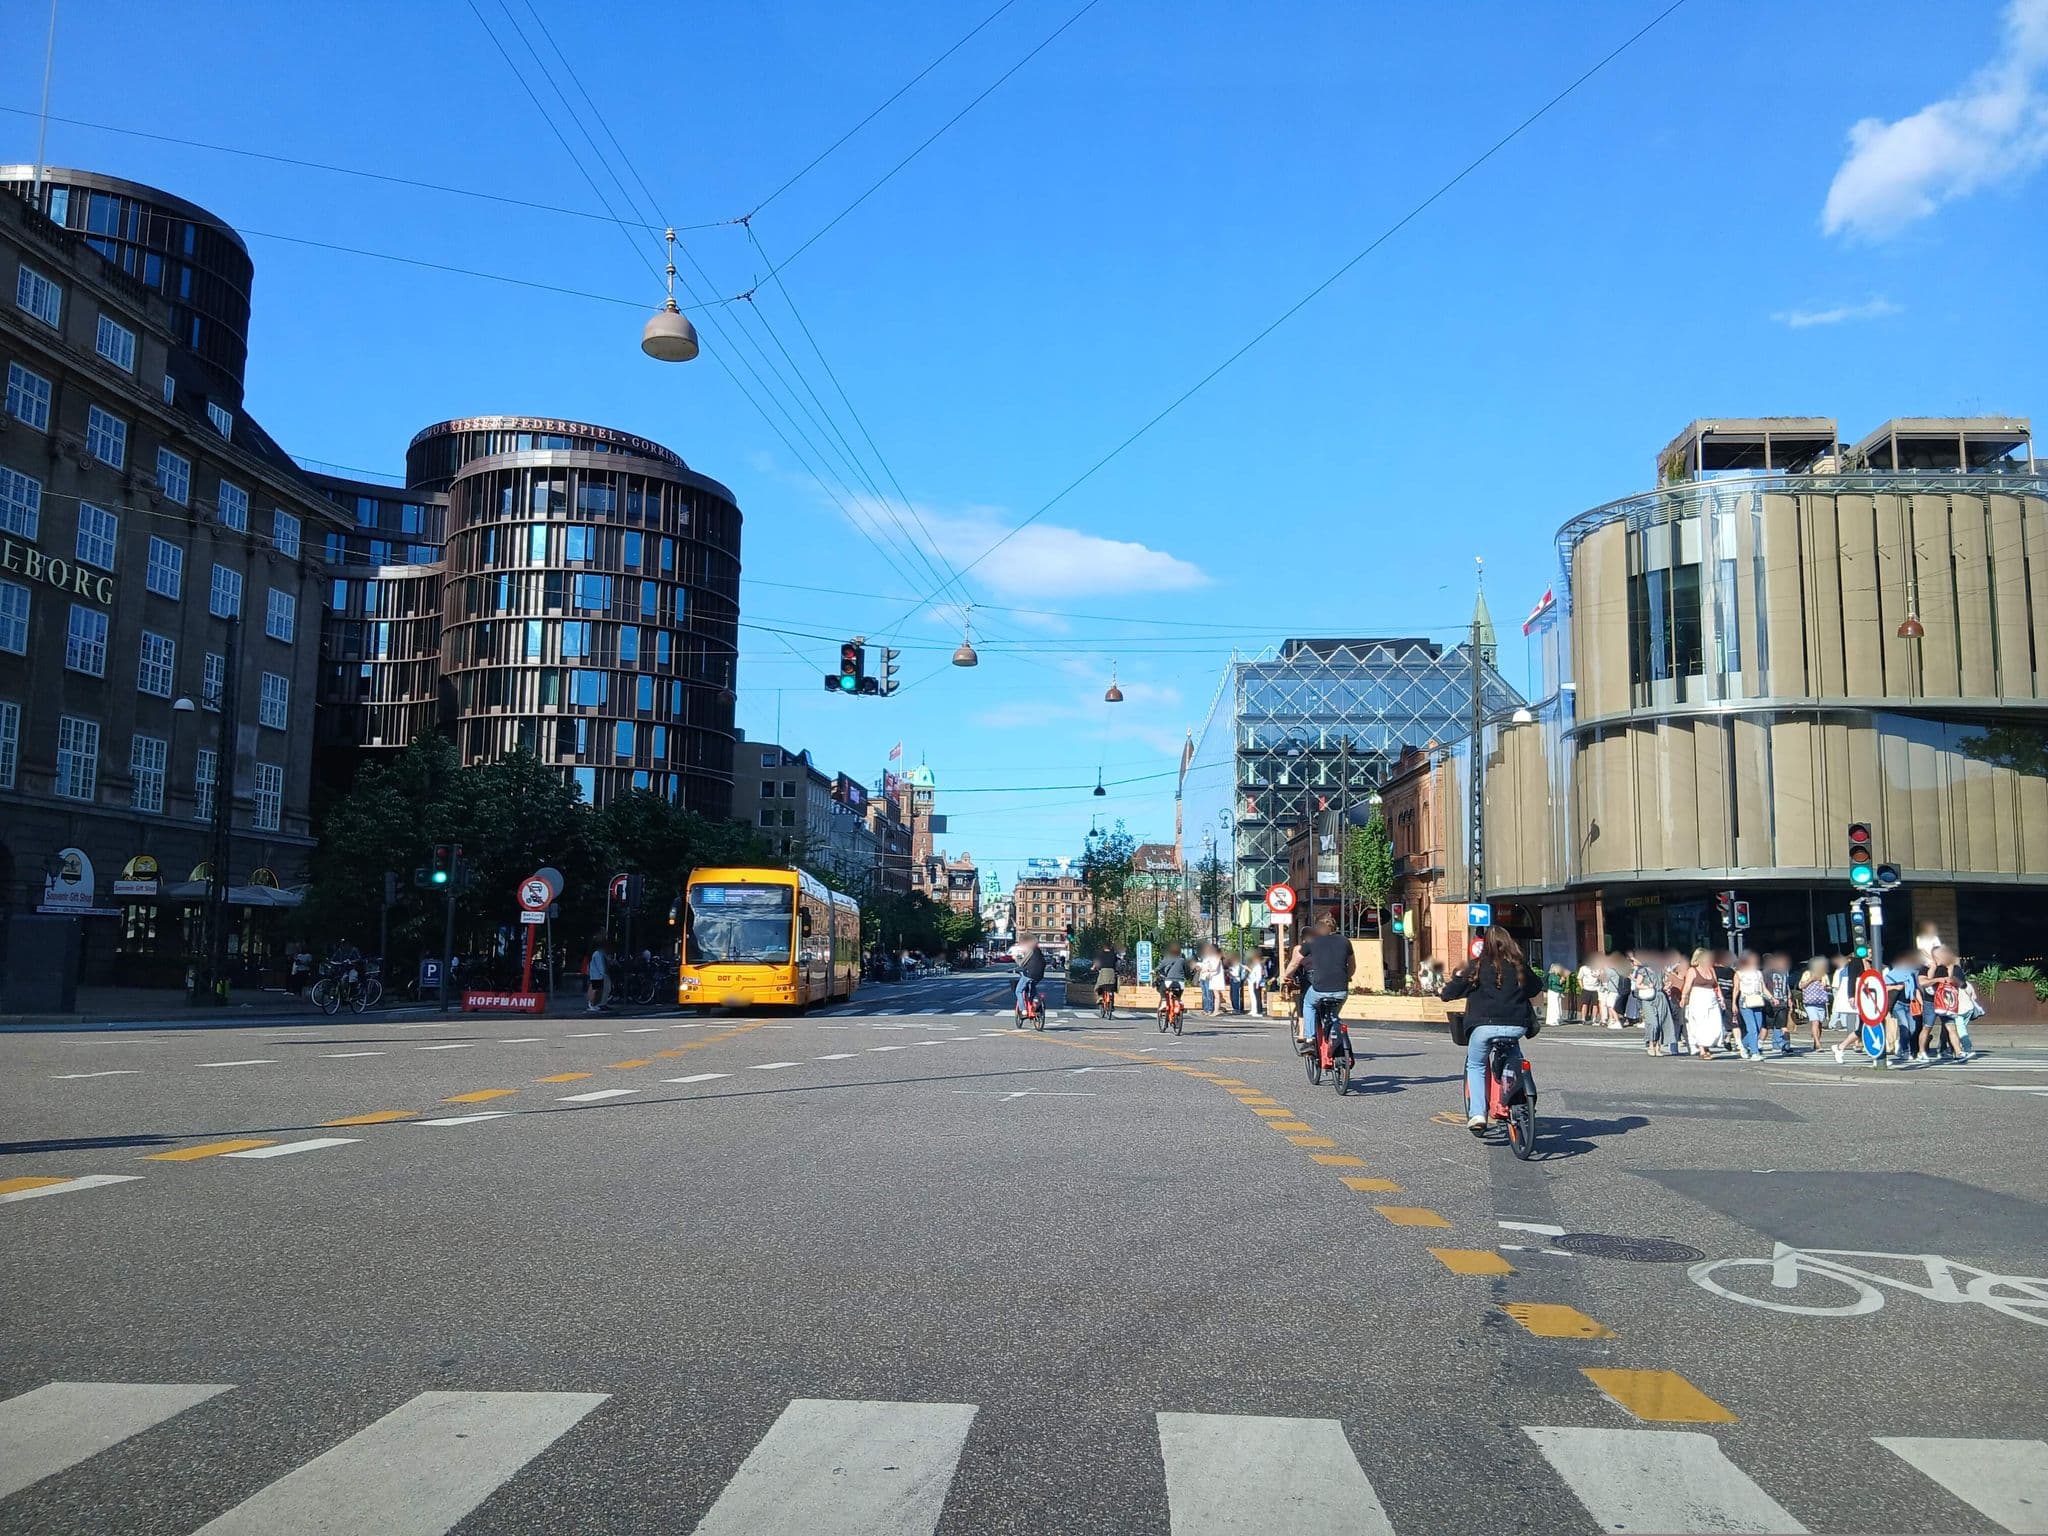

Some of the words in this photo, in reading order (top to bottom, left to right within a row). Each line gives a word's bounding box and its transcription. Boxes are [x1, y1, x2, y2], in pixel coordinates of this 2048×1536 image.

[511, 418, 617, 441] FEDERSPIEL
[428, 964, 437, 977] P
[468, 996, 536, 1007] HOFFMANN
